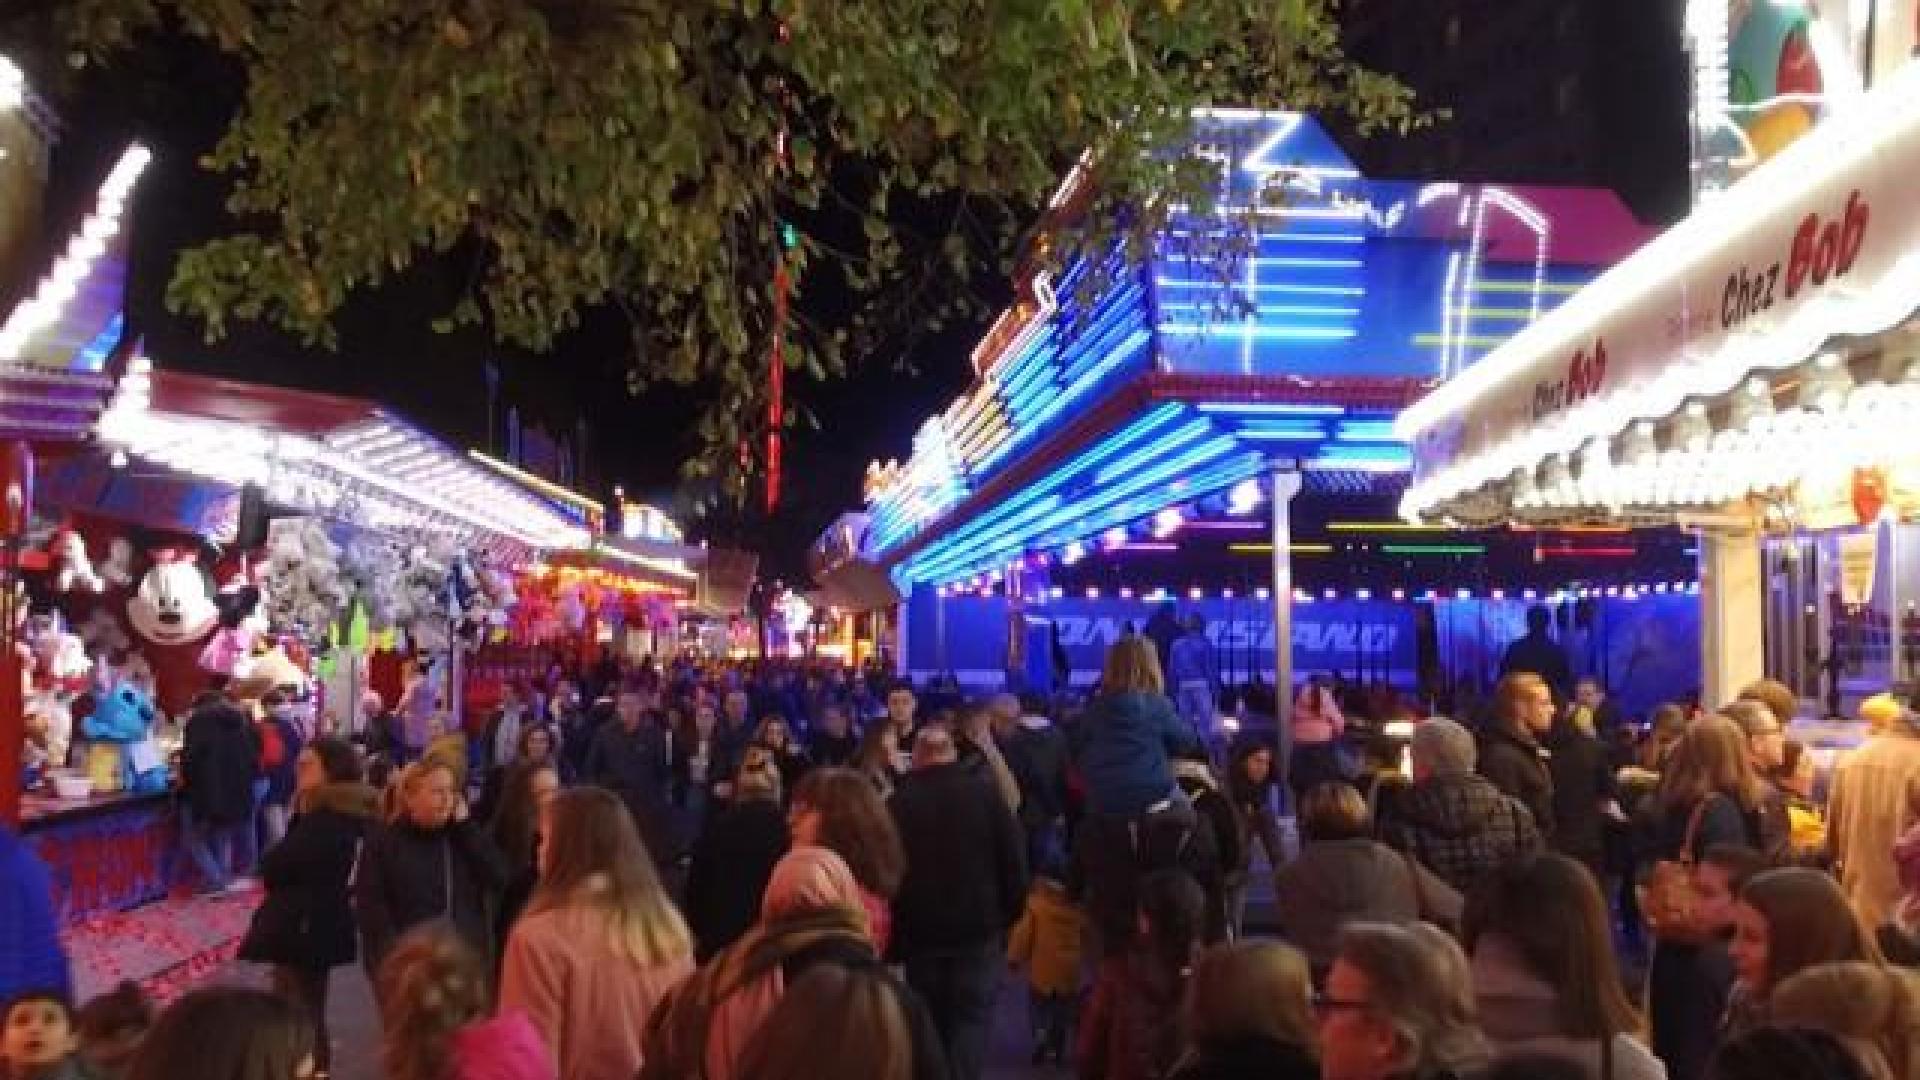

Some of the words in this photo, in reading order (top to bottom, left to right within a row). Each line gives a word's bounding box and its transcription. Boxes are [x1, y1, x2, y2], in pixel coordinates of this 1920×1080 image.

[1721, 264, 1780, 328] Chez
[1784, 188, 1870, 298] Bob
[1565, 336, 1607, 405] Bob
